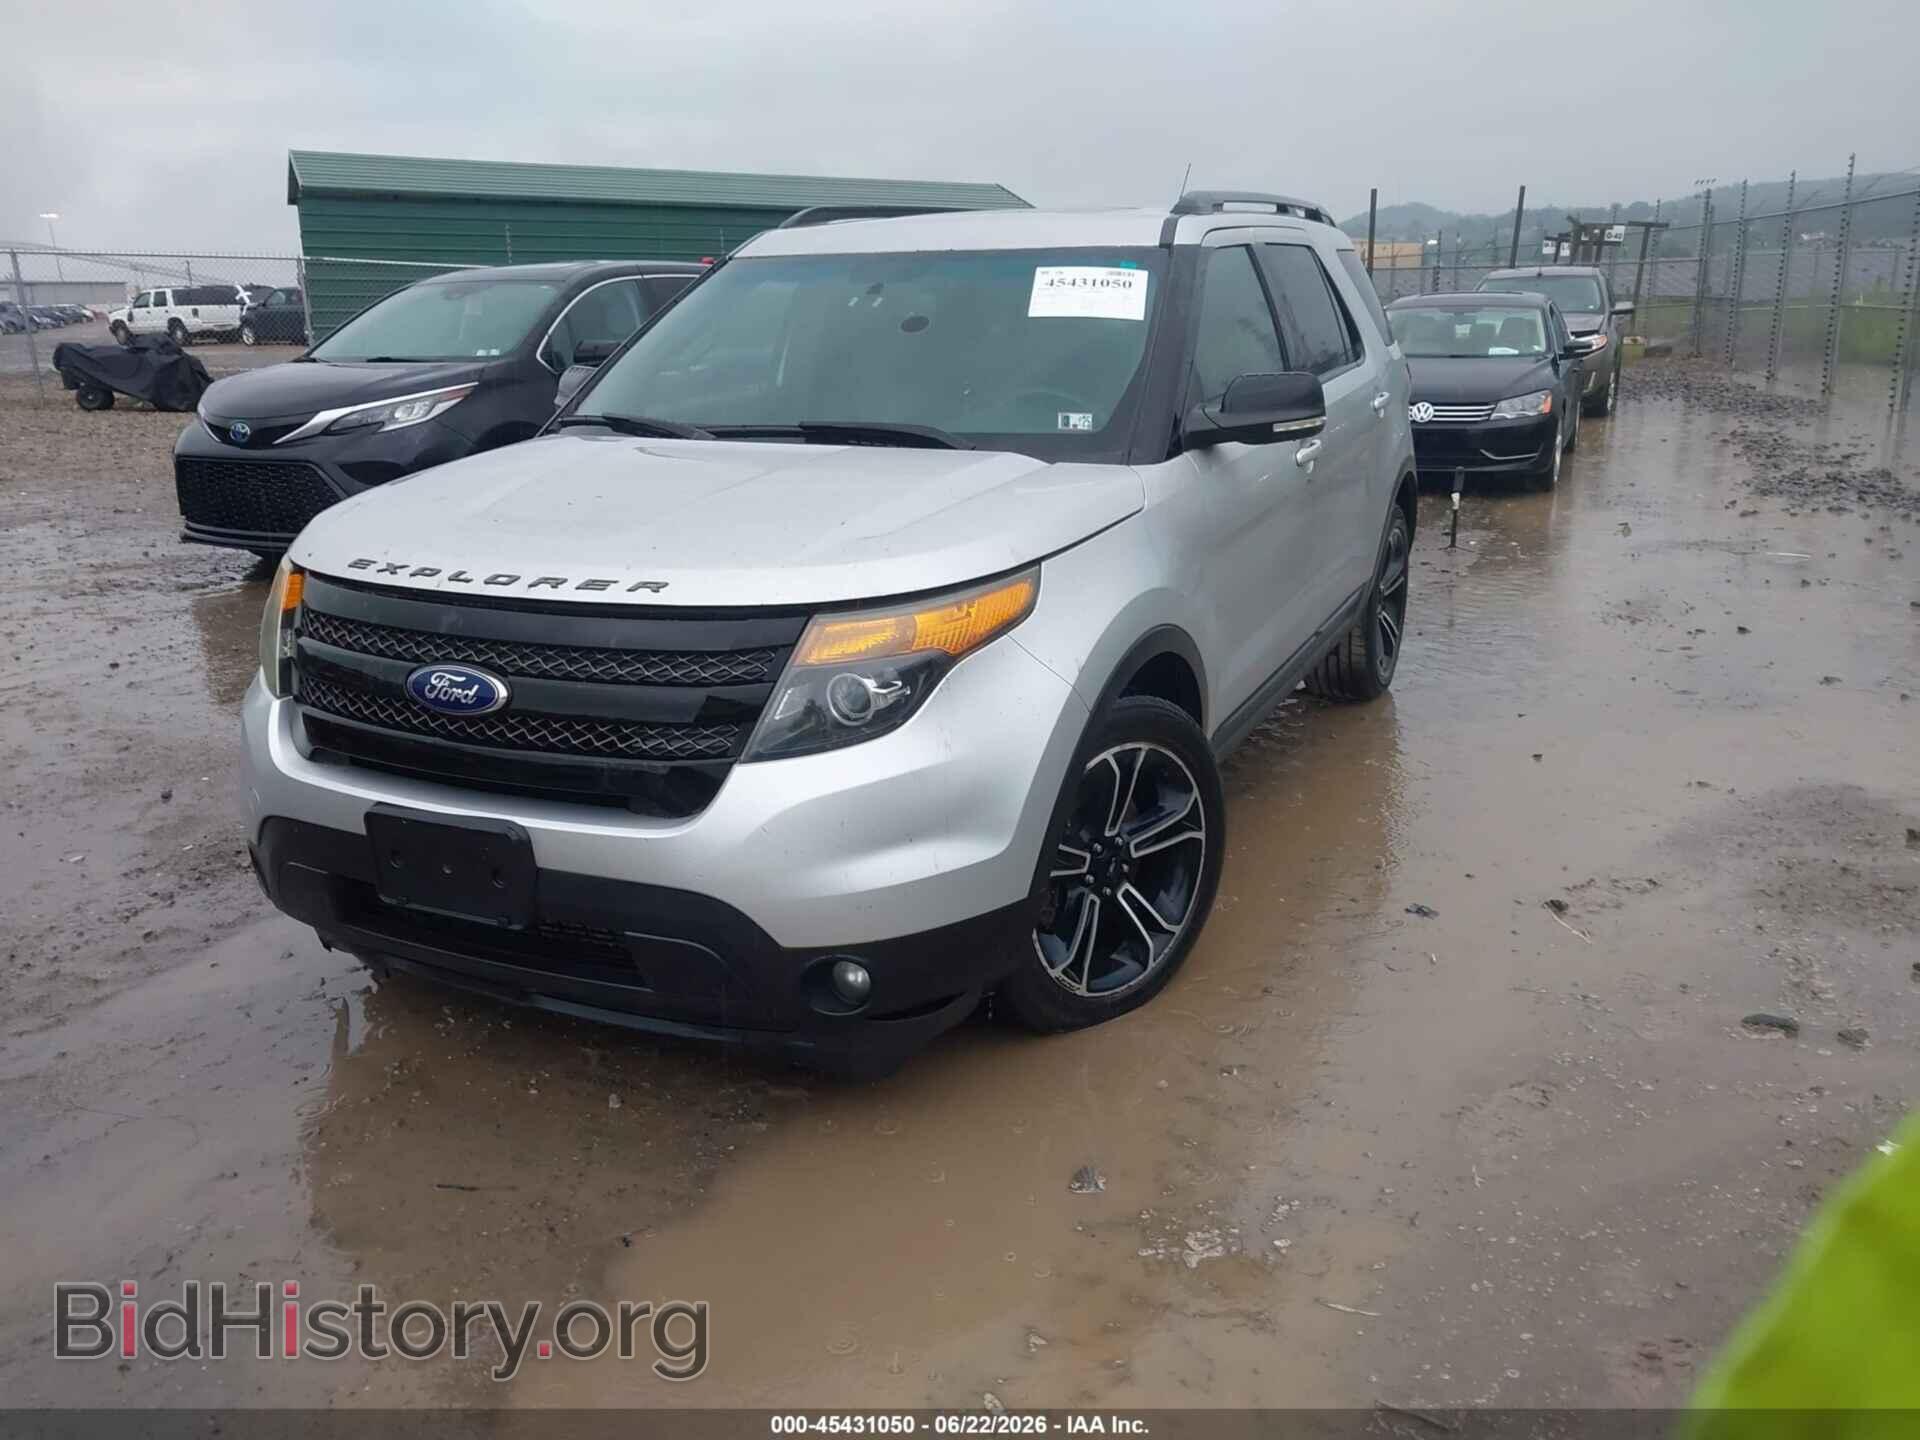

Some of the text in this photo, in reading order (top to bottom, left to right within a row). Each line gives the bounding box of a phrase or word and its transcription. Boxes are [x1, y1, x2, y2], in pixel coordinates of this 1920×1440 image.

[1044, 277, 1133, 289] 45431050
[347, 557, 670, 593] EXPLORER
[424, 671, 479, 705] Ford
